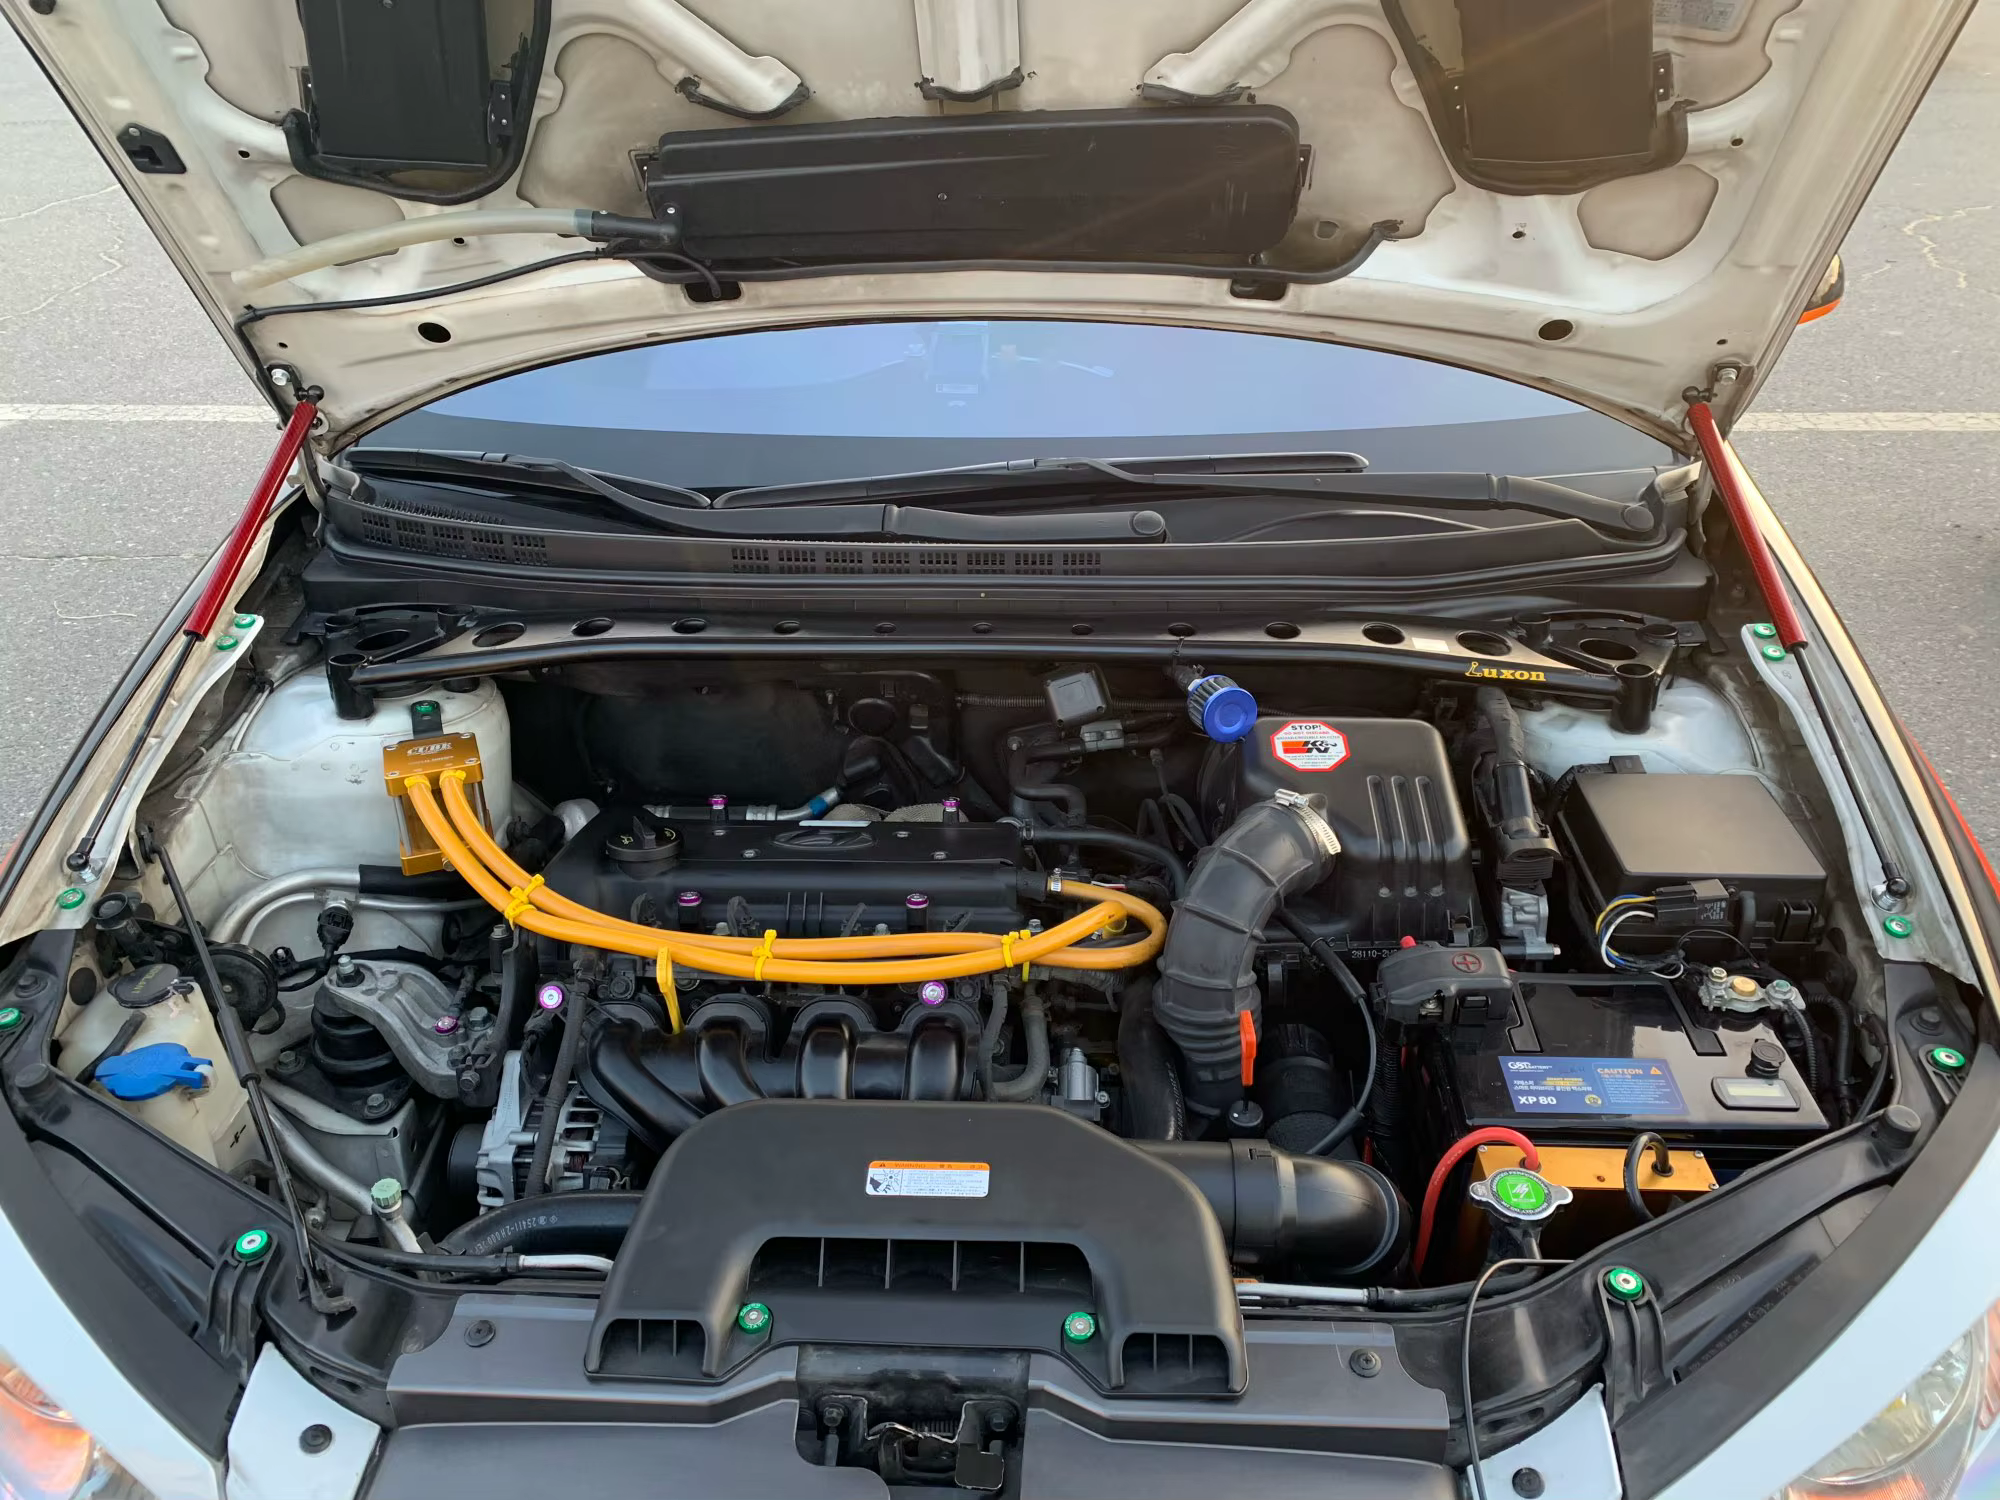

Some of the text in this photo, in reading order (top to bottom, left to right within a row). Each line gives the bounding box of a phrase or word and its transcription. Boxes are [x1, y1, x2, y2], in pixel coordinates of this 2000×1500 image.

[1465, 661, 1546, 682] Luxon
[1596, 1067, 1644, 1075] CAUTION
[1518, 1096, 1557, 1105] XP 80
